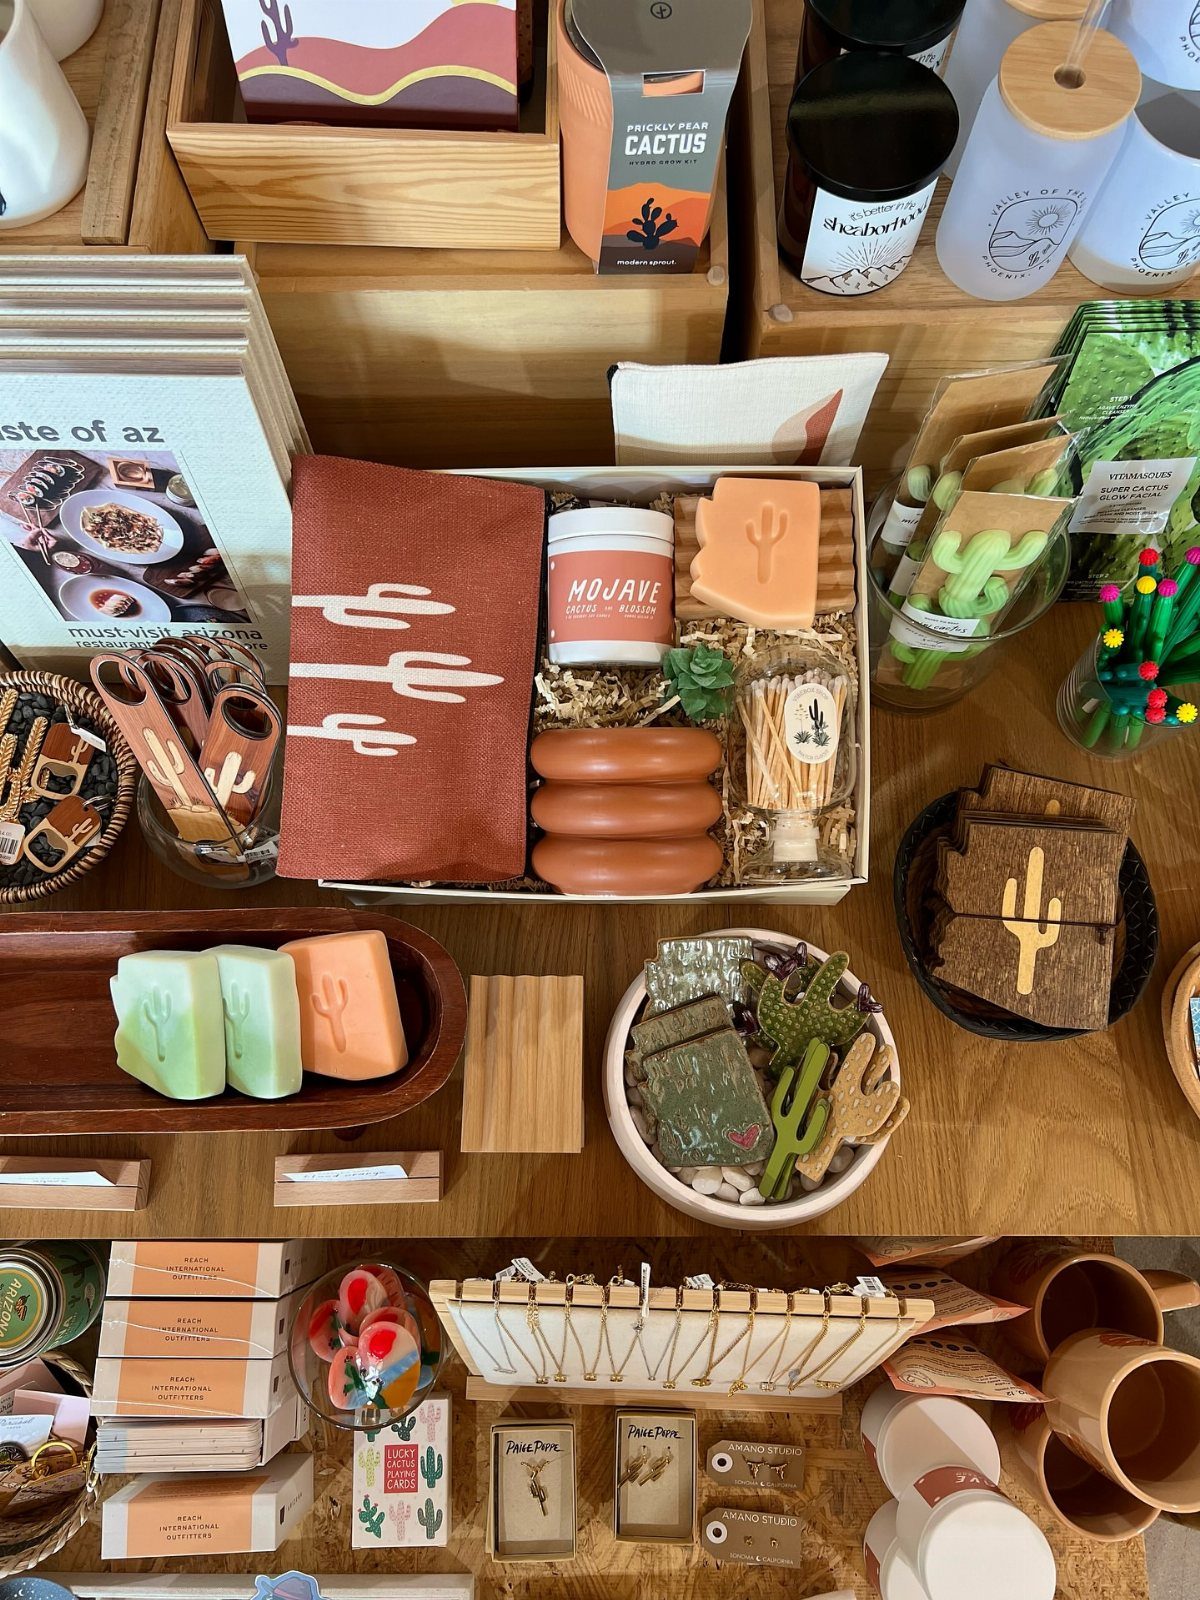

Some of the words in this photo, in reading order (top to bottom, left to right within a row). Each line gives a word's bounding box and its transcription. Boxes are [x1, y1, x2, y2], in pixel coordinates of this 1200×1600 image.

[627, 123, 675, 133] PRICKLY
[678, 122, 709, 131] PEAR
[624, 133, 708, 156] CACTUS
[991, 189, 1031, 217] VALLEY
[1040, 188, 1060, 197] OF
[1144, 192, 1190, 220] VALLEY
[823, 194, 930, 237] sheaborhood
[862, 203, 895, 219] better
[71, 419, 107, 443] of
[122, 426, 165, 443] az
[1109, 471, 1173, 481] VITAMASQUES
[1100, 486, 1131, 494] SUPER
[1132, 484, 1169, 493] CACTUS
[1129, 491, 1162, 500] FACIAL
[567, 578, 662, 604] MOJAVE
[565, 604, 598, 615] CACTUS
[618, 604, 657, 615] BLOSSOM
[68, 626, 171, 639] must-visit
[182, 626, 263, 640] arizona
[158, 1326, 219, 1334] INTERNATIONAL
[387, 1449, 416, 1459] LUCKY
[727, 1443, 765, 1454] AMANO
[767, 1446, 803, 1456] STUDIO
[386, 1460, 416, 1469] CACTUS
[387, 1470, 416, 1479] PLAYING
[386, 1478, 416, 1490] CARDS
[721, 1511, 760, 1523] AMANO
[761, 1515, 798, 1527] STUDIO
[159, 1523, 220, 1532] INTERNATIONAL
[166, 1533, 212, 1541] OUTFITTERS
[729, 1552, 755, 1560] SONOMA
[762, 1556, 794, 1566] CALIFORNIA
